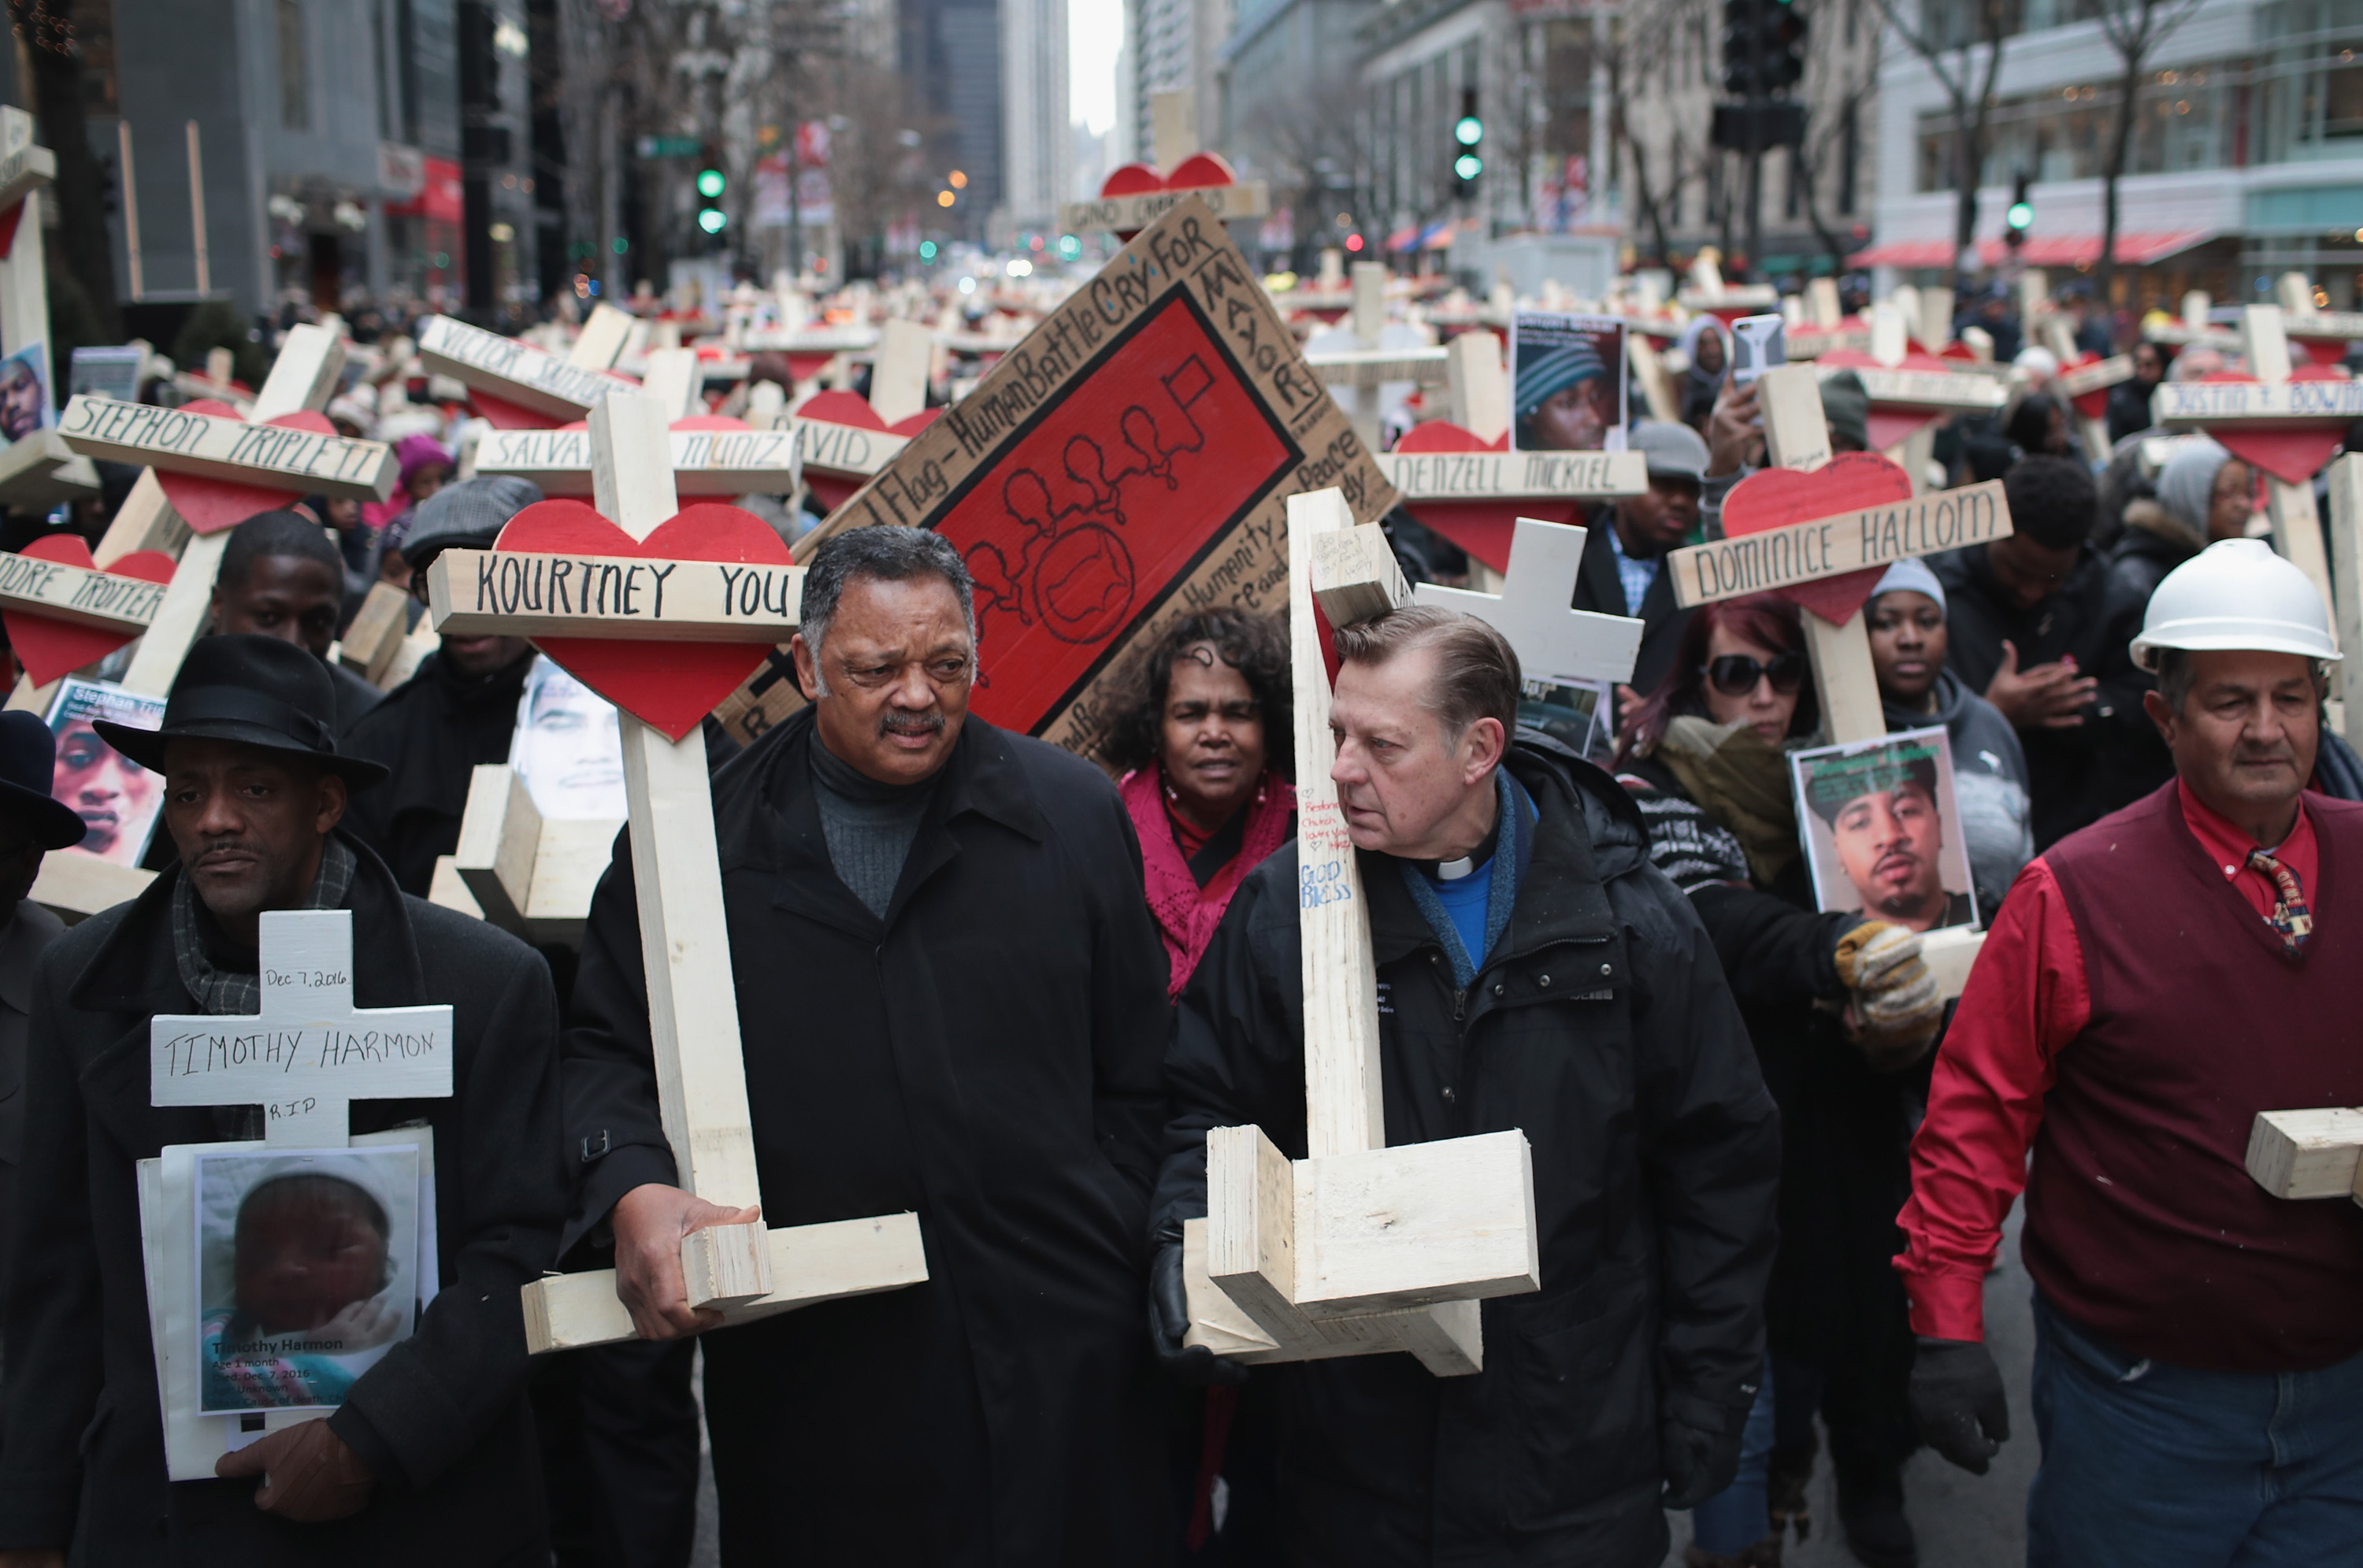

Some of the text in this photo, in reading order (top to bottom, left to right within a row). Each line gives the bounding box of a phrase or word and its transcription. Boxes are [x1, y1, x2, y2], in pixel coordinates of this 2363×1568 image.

[440, 323, 525, 382] VICTOR
[1199, 258, 1315, 408] MAYOR
[65, 398, 382, 482] STEPHON TRIPLETT
[681, 431, 786, 467] MUNIZ
[1395, 454, 1504, 492] DENZELL
[1524, 452, 1618, 490] MICKIEL
[1695, 490, 1996, 599] DOMINICE HALLOM
[71, 571, 165, 621] TROTTER
[477, 554, 677, 618] KOURTNEY
[314, 970, 347, 988] 2016
[164, 1031, 435, 1077] TIMOTHY HARMON
[212, 1339, 343, 1355] Timothy Harmon
[212, 1358, 279, 1370] Age 1 month
[237, 1384, 288, 1394] Unknown
[283, 1369, 310, 1379] 2016
[243, 1398, 276, 1407] Cause
[279, 1396, 290, 1407] of
